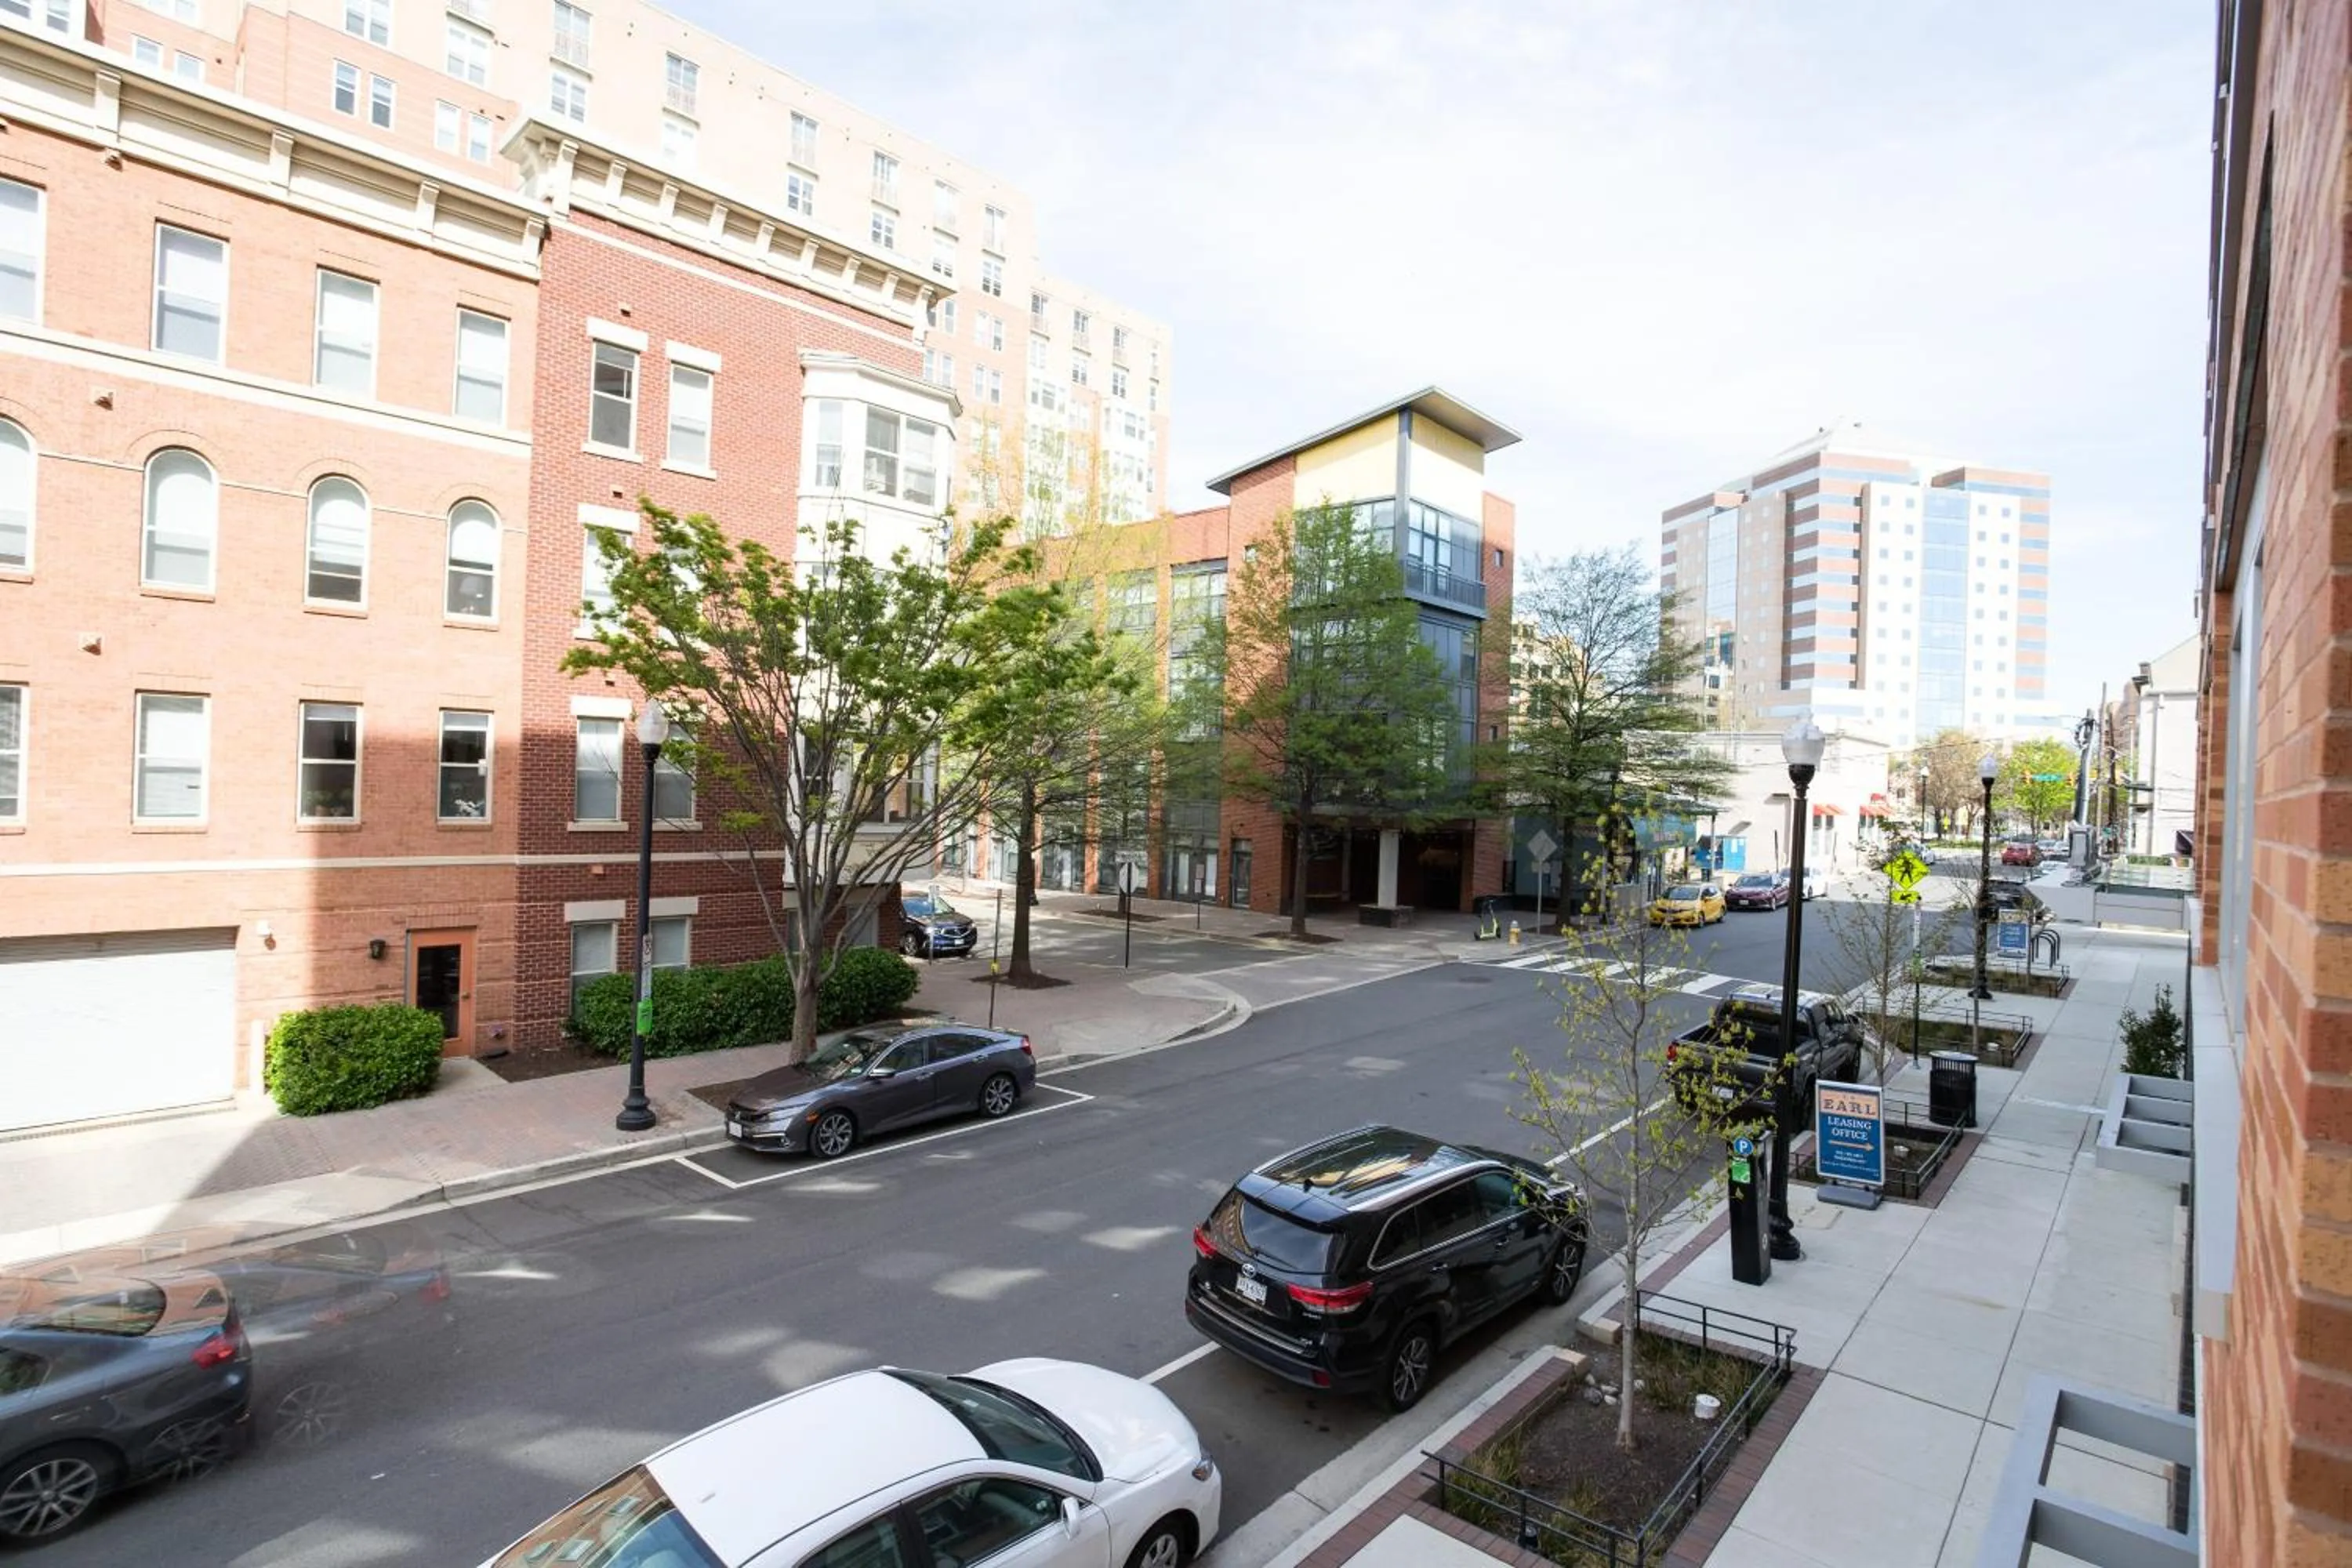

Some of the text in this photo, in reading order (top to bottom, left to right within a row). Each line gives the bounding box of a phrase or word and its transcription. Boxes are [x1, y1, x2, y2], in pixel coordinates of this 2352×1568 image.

[1824, 1099, 1876, 1116] EARL
[1828, 1116, 1872, 1130] LEASING
[1831, 1127, 1868, 1141] OFFICE
[1739, 1140, 1748, 1153] P
